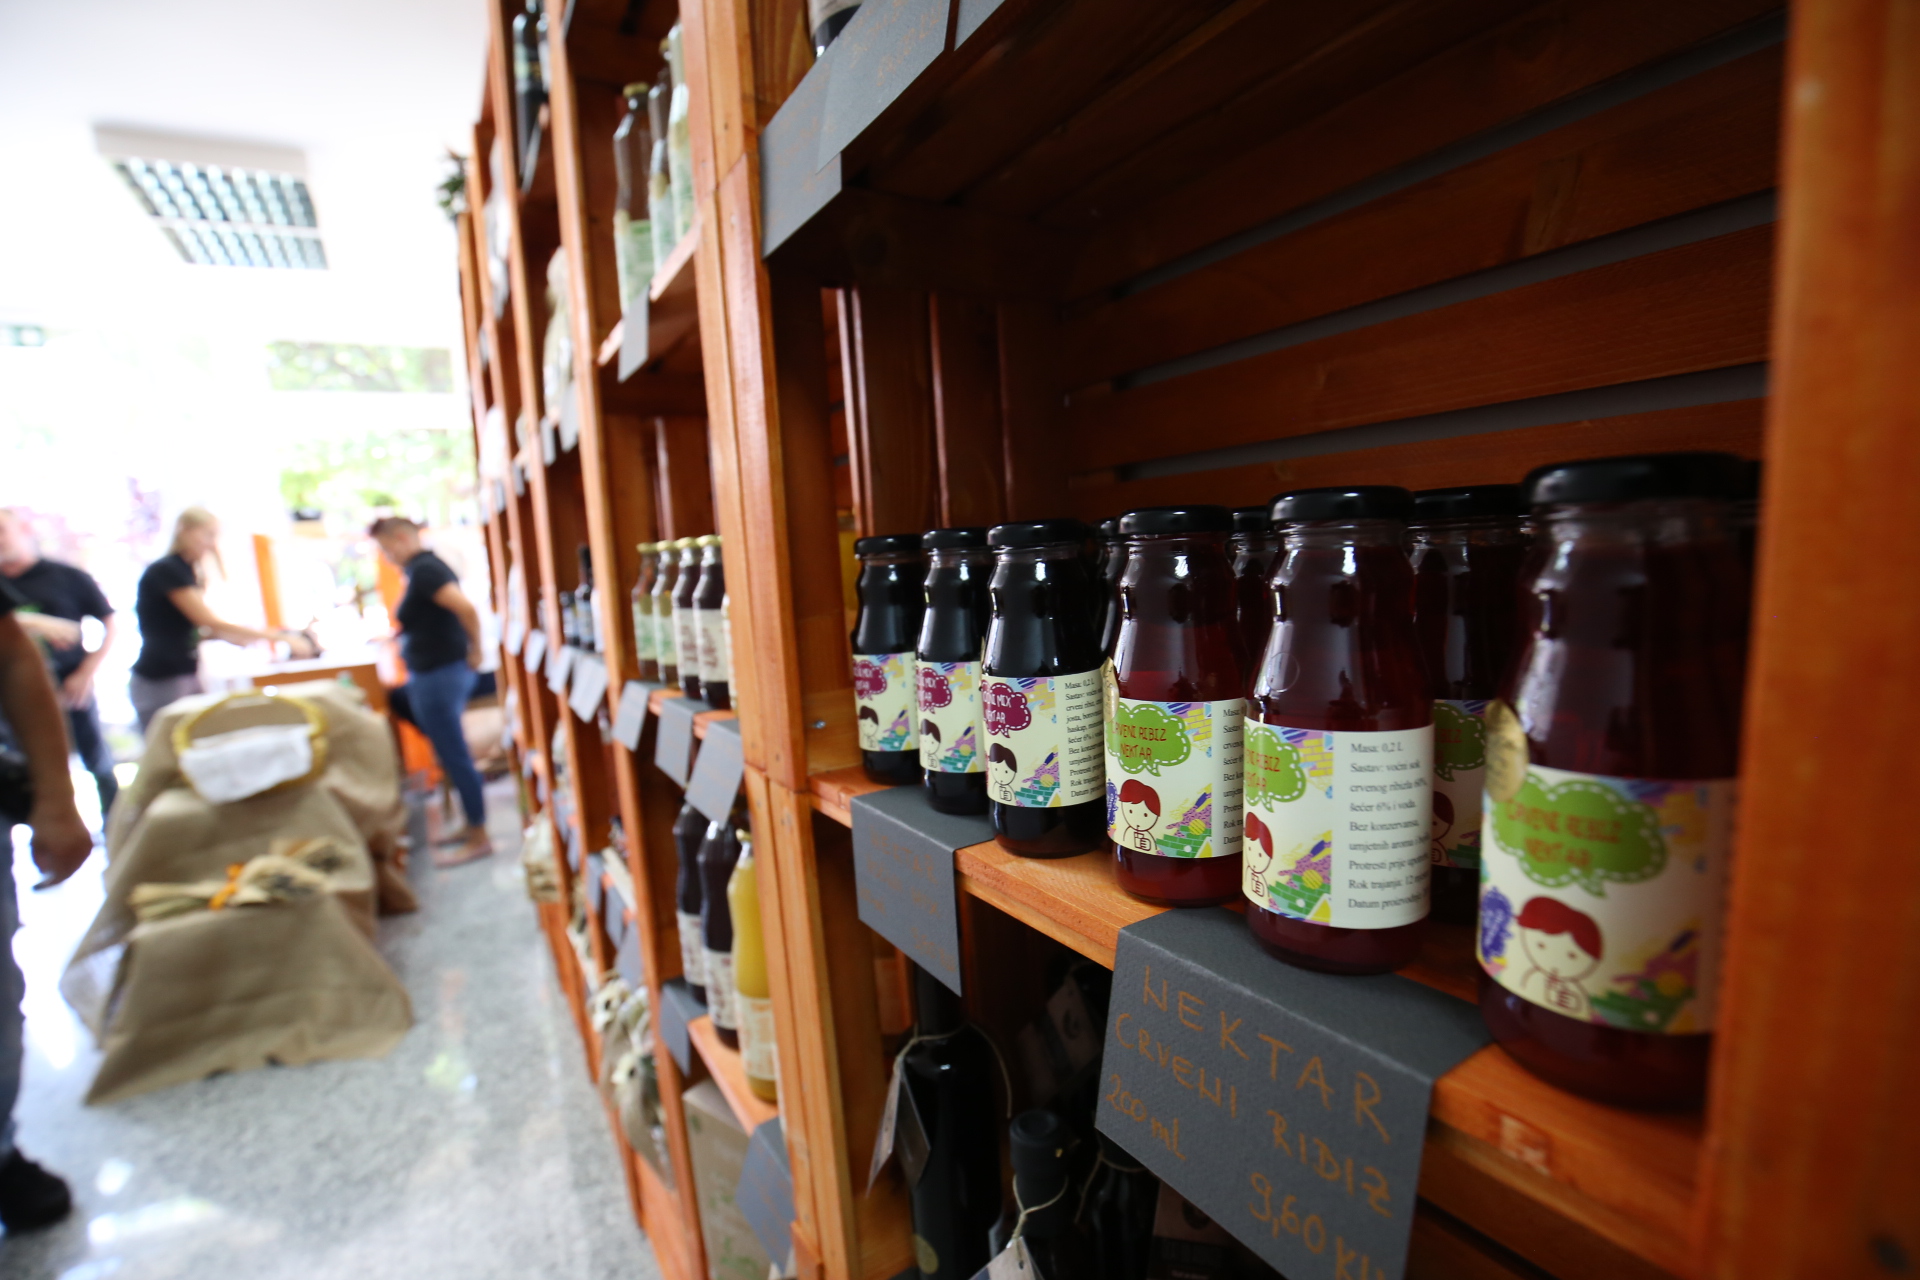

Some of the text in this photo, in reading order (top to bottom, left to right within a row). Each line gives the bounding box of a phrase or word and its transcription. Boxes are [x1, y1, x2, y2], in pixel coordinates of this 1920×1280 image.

[1349, 820, 1369, 831] Bez
[1348, 879, 1369, 889] Rok
[1348, 898, 1380, 909] Datum
[1115, 1013, 1237, 1119] CRVENI
[1143, 965, 1391, 1144] NEKTAR
[1105, 1073, 1148, 1122] 200
[1249, 1171, 1327, 1255] 9,60
